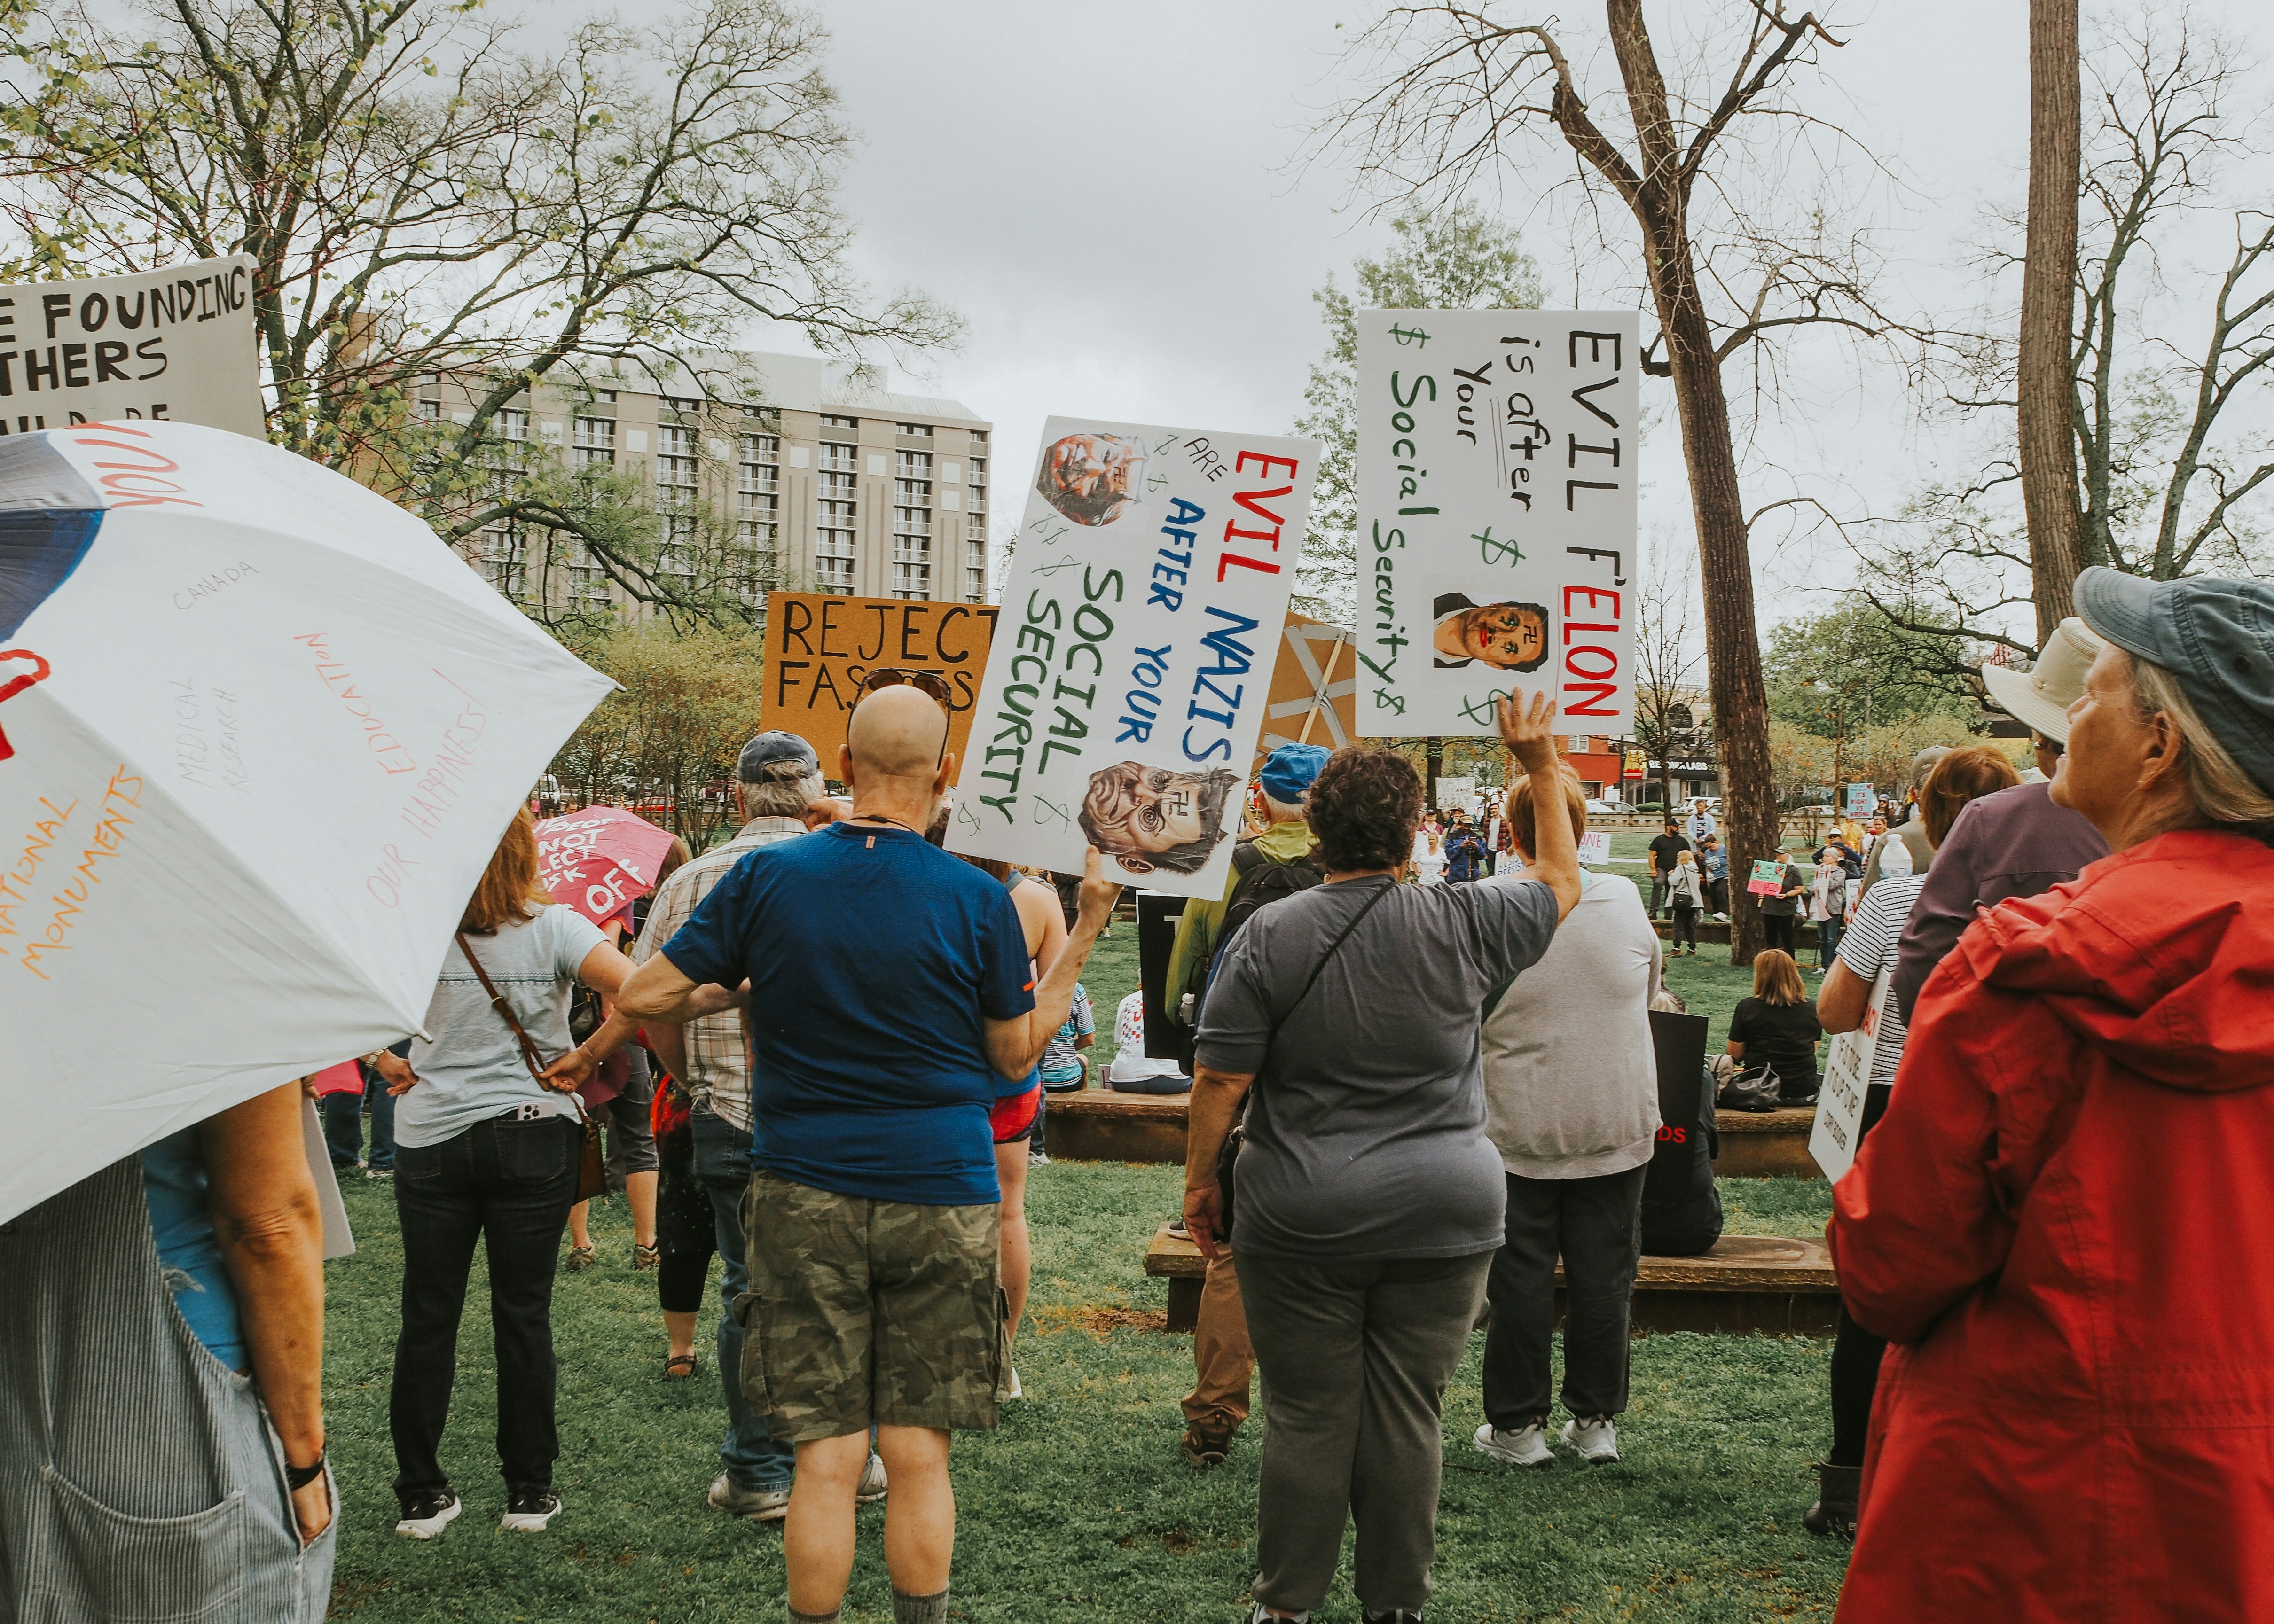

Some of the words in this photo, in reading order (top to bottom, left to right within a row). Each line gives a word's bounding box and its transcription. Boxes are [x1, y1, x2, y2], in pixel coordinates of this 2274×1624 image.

[43, 265, 246, 339] FOUNDING
[1500, 336, 1540, 375] is
[1391, 370, 1440, 516] Social
[1453, 360, 1493, 446] Your
[1507, 391, 1551, 513] after
[1566, 330, 1622, 512] EVIL
[1184, 437, 1228, 482] ARE
[1147, 497, 1207, 612] AFTER
[1217, 450, 1299, 583] EVIL
[173, 561, 260, 609] CANADA
[783, 601, 1000, 663] REJECT
[1357, 518, 1409, 686] Security
[292, 632, 416, 774] EDUCATION
[979, 588, 1062, 826] SECURITY
[1037, 562, 1123, 775] SOCIAL
[1115, 644, 1172, 744] YOUR
[1182, 605, 1261, 763] NAZIS
[168, 677, 215, 789] MEDICAL
[211, 687, 251, 794] RESEARCH
[1685, 762, 1708, 771] LABS
[21, 764, 144, 980] MONUMENTS
[367, 843, 422, 908] OUR
[538, 828, 606, 858] NOT
[586, 858, 646, 914] OFF
